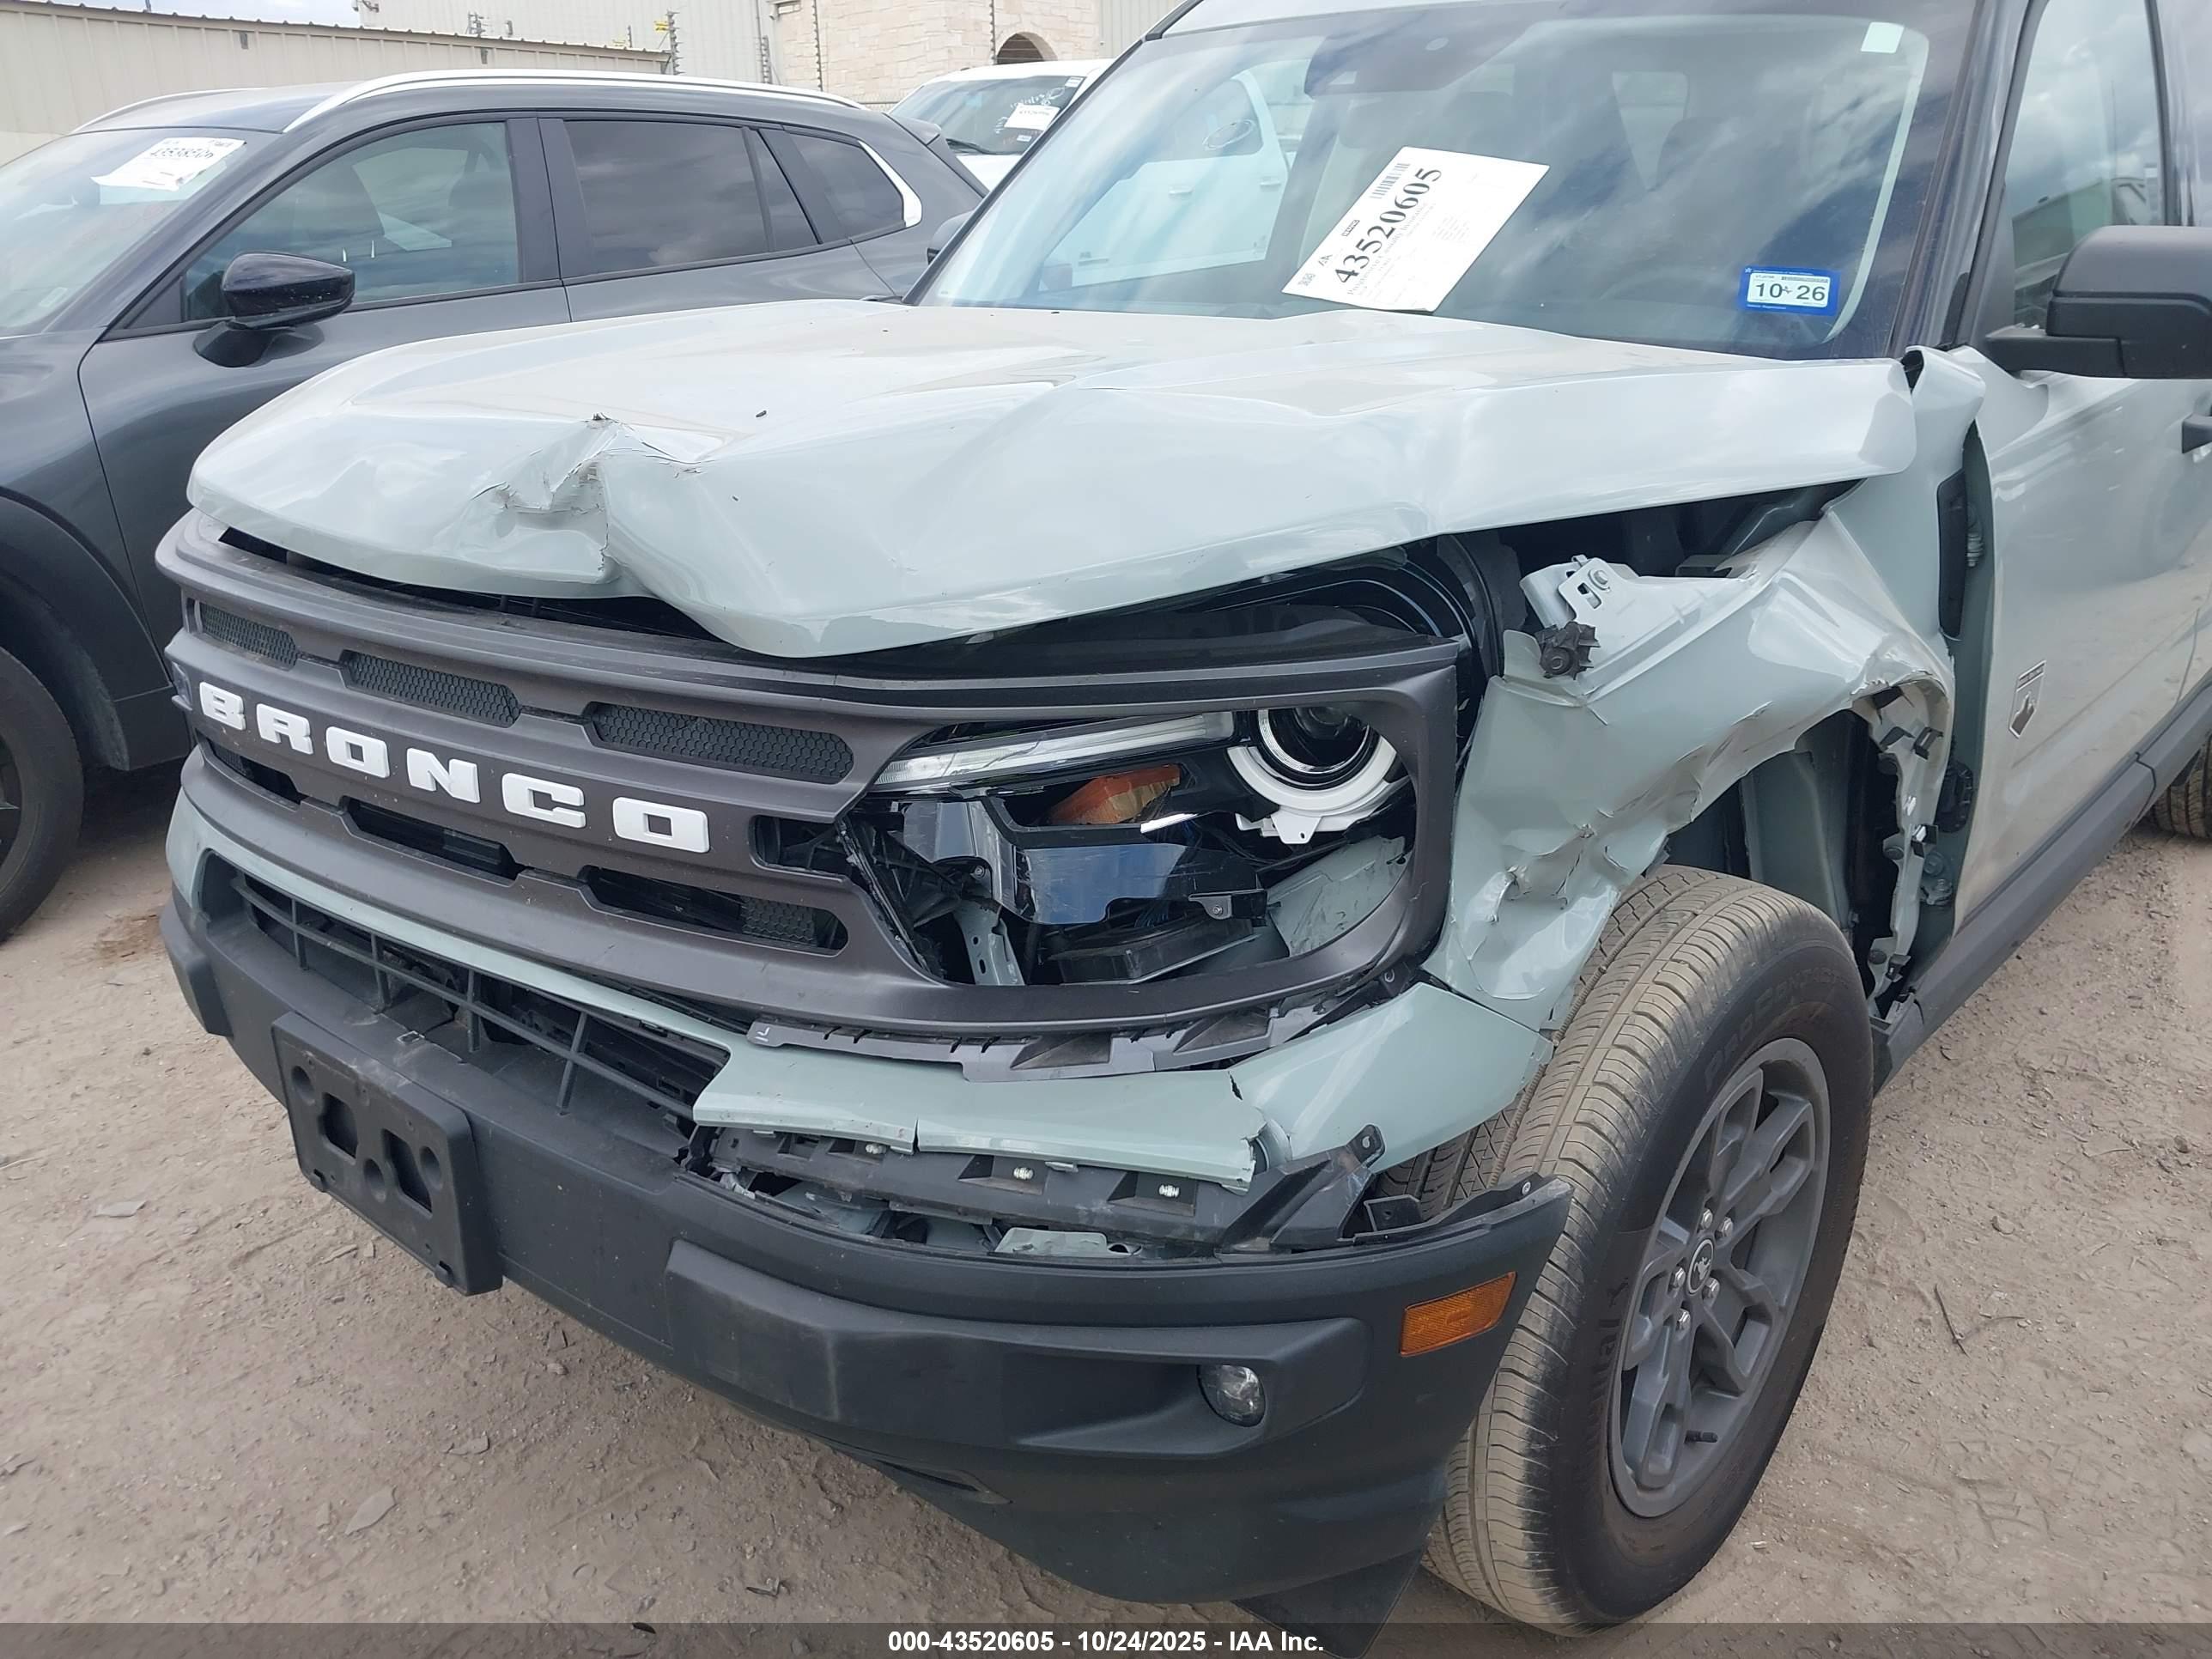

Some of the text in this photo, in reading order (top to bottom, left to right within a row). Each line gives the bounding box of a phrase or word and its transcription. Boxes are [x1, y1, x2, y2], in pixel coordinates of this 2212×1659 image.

[1335, 167, 1442, 283] 43520605
[1755, 283, 1827, 301] 10 26
[199, 681, 711, 854] BRONCO
